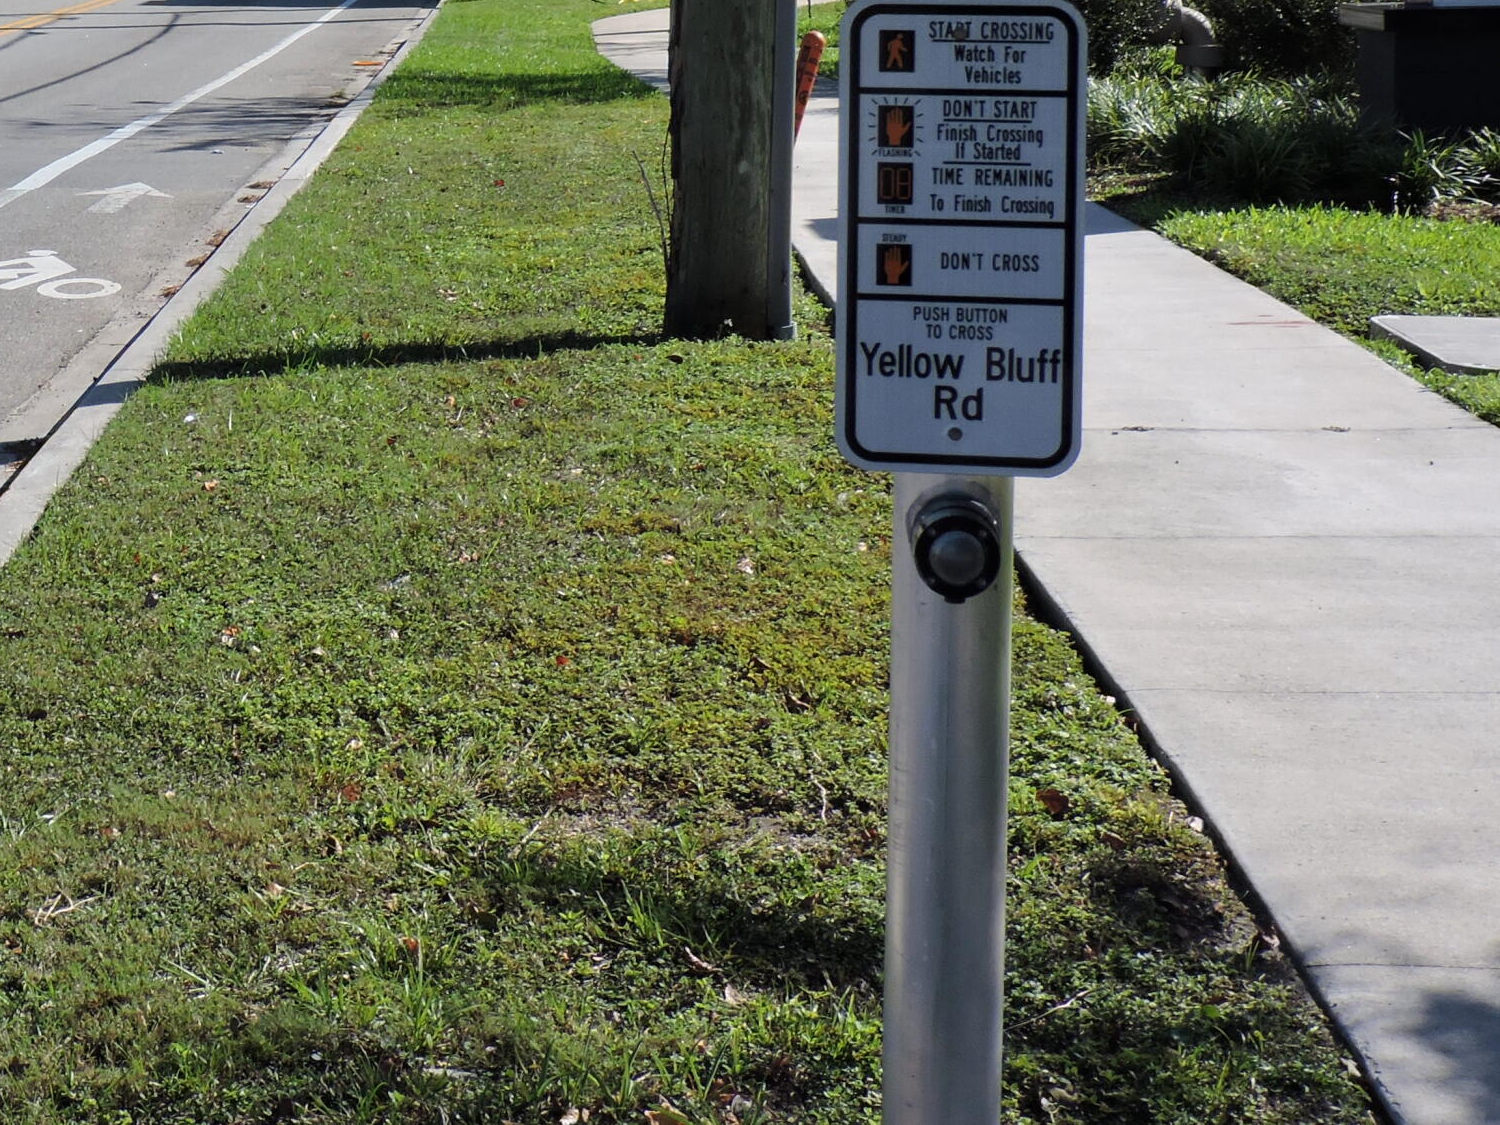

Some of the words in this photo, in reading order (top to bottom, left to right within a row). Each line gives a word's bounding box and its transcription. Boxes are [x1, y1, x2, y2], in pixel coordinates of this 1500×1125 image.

[980, 22, 1054, 41] CROSSING
[954, 45, 995, 63] Watch
[1004, 46, 1026, 64] For
[965, 66, 1022, 84] Vehicles
[943, 100, 986, 118] DON'T
[993, 101, 1037, 119] START
[937, 125, 977, 142] Finish
[987, 126, 1043, 147] Crossing
[955, 143, 965, 159] If
[973, 144, 1021, 161] Started
[932, 168, 964, 186] TIME
[975, 169, 1053, 188] REMAINING
[930, 194, 944, 212] To
[954, 195, 991, 214] Finish
[1001, 196, 1055, 218] Crossing
[940, 252, 984, 271] DON'T
[992, 254, 1039, 272] CROSS
[913, 306, 949, 322] PUSH
[956, 307, 1008, 324] BUTTON
[926, 324, 942, 339] TO
[949, 325, 993, 341] CROSS
[859, 341, 965, 379] Yellow
[986, 347, 1061, 384] Bluff
[934, 385, 984, 421] Rd
